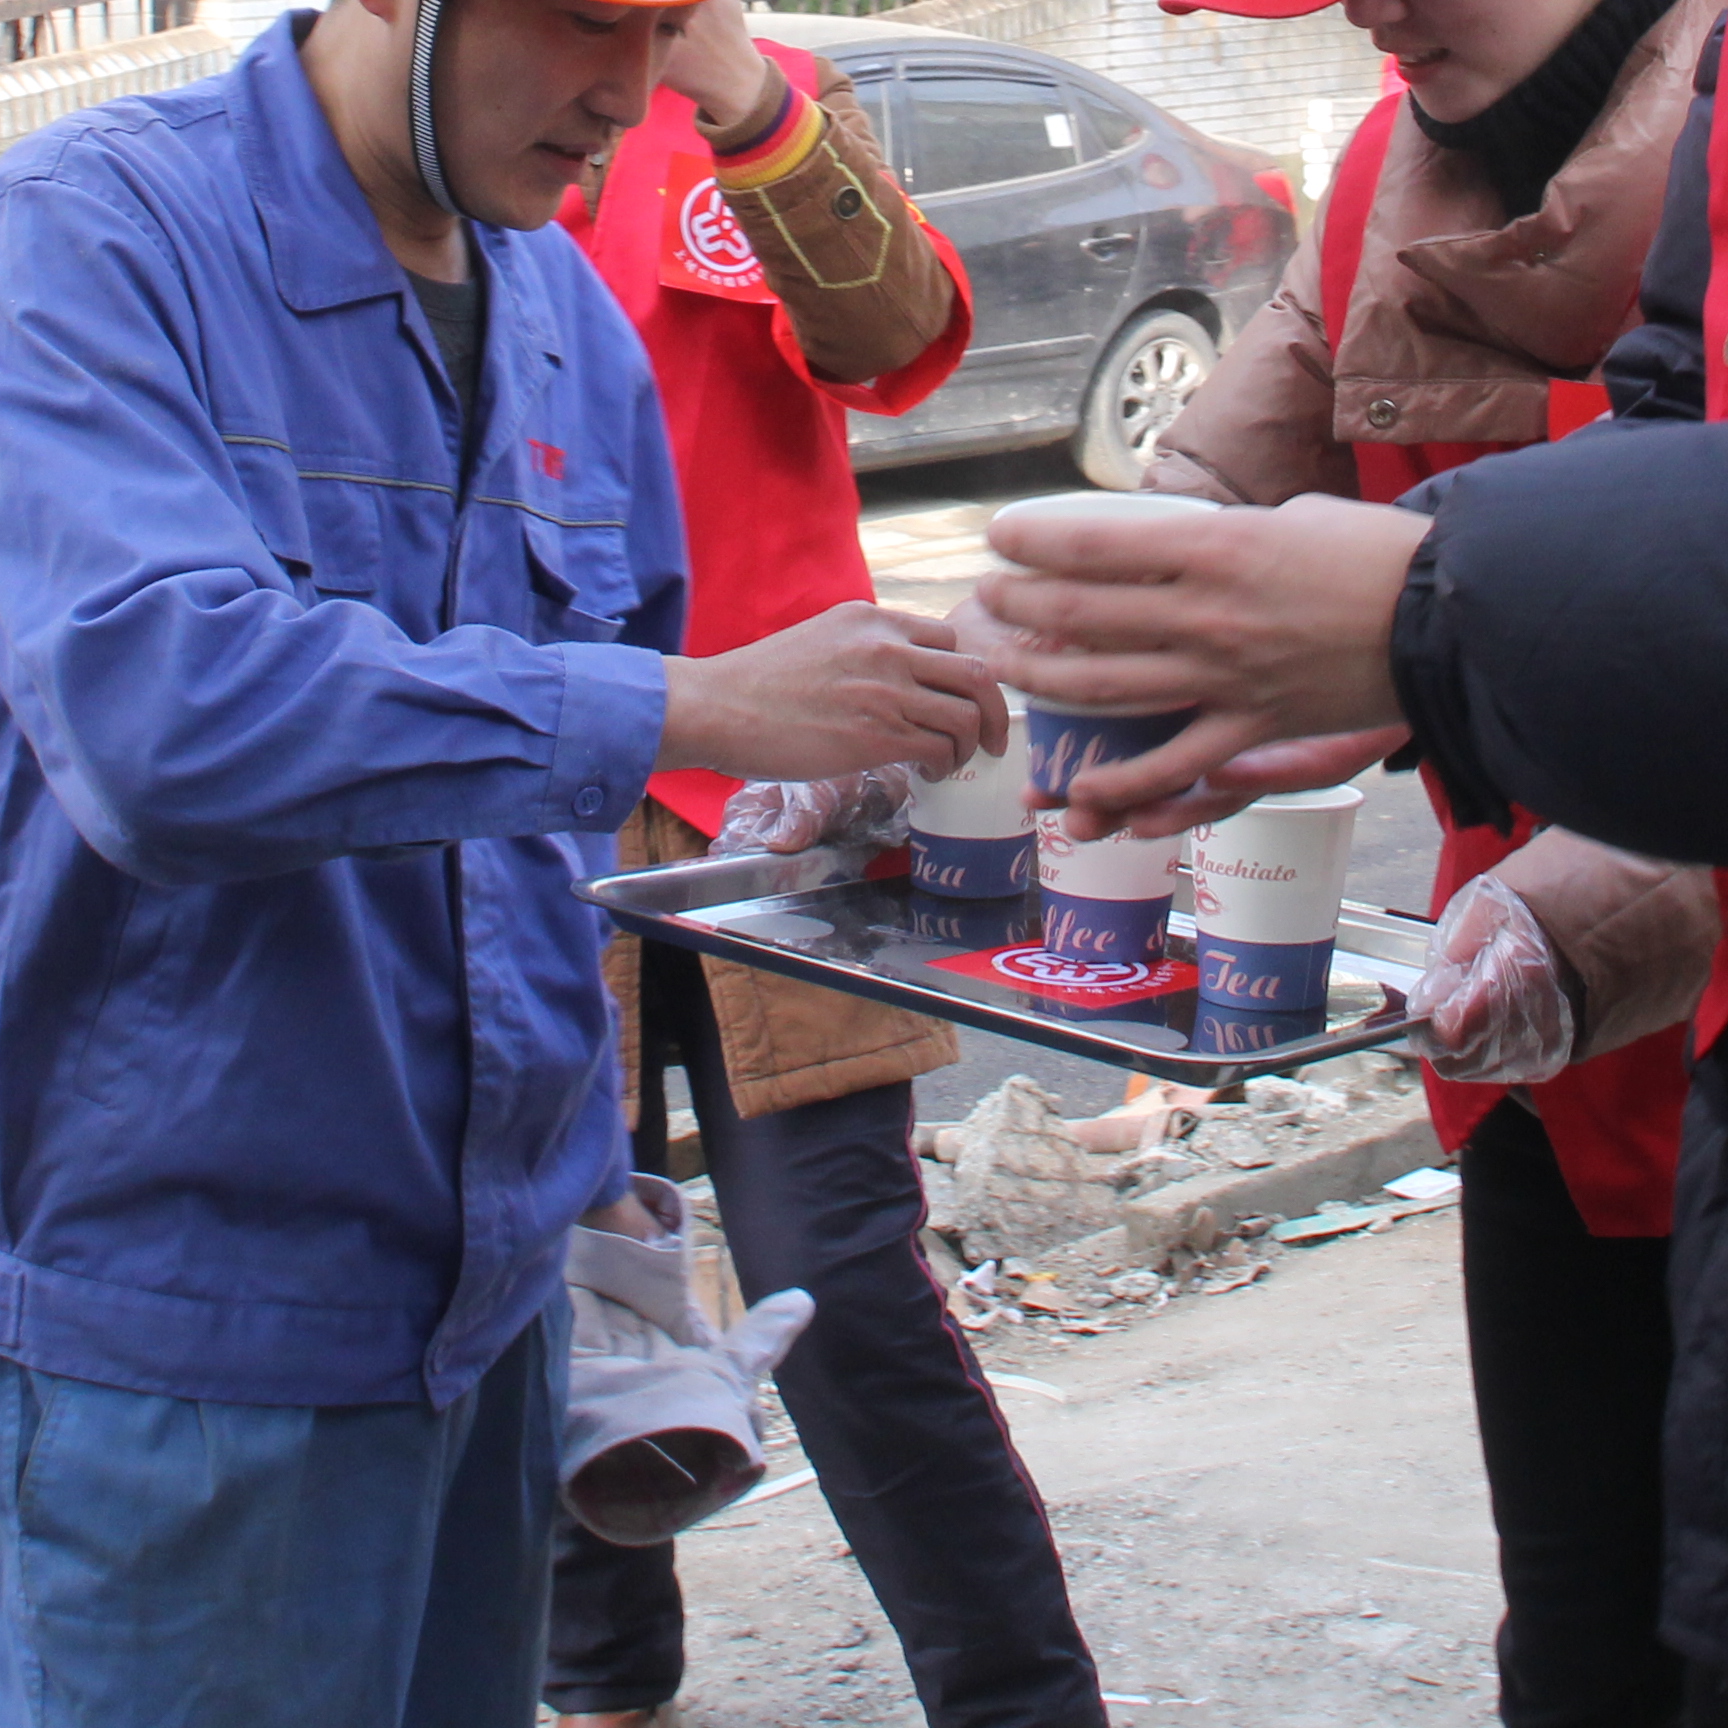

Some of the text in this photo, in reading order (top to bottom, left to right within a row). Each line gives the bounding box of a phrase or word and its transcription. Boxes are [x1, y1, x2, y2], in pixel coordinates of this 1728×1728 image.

[910, 840, 966, 888] Tea
[1194, 849, 1298, 882] Macchiato
[1042, 904, 1116, 953] ffee
[1204, 949, 1282, 1000] Tea
